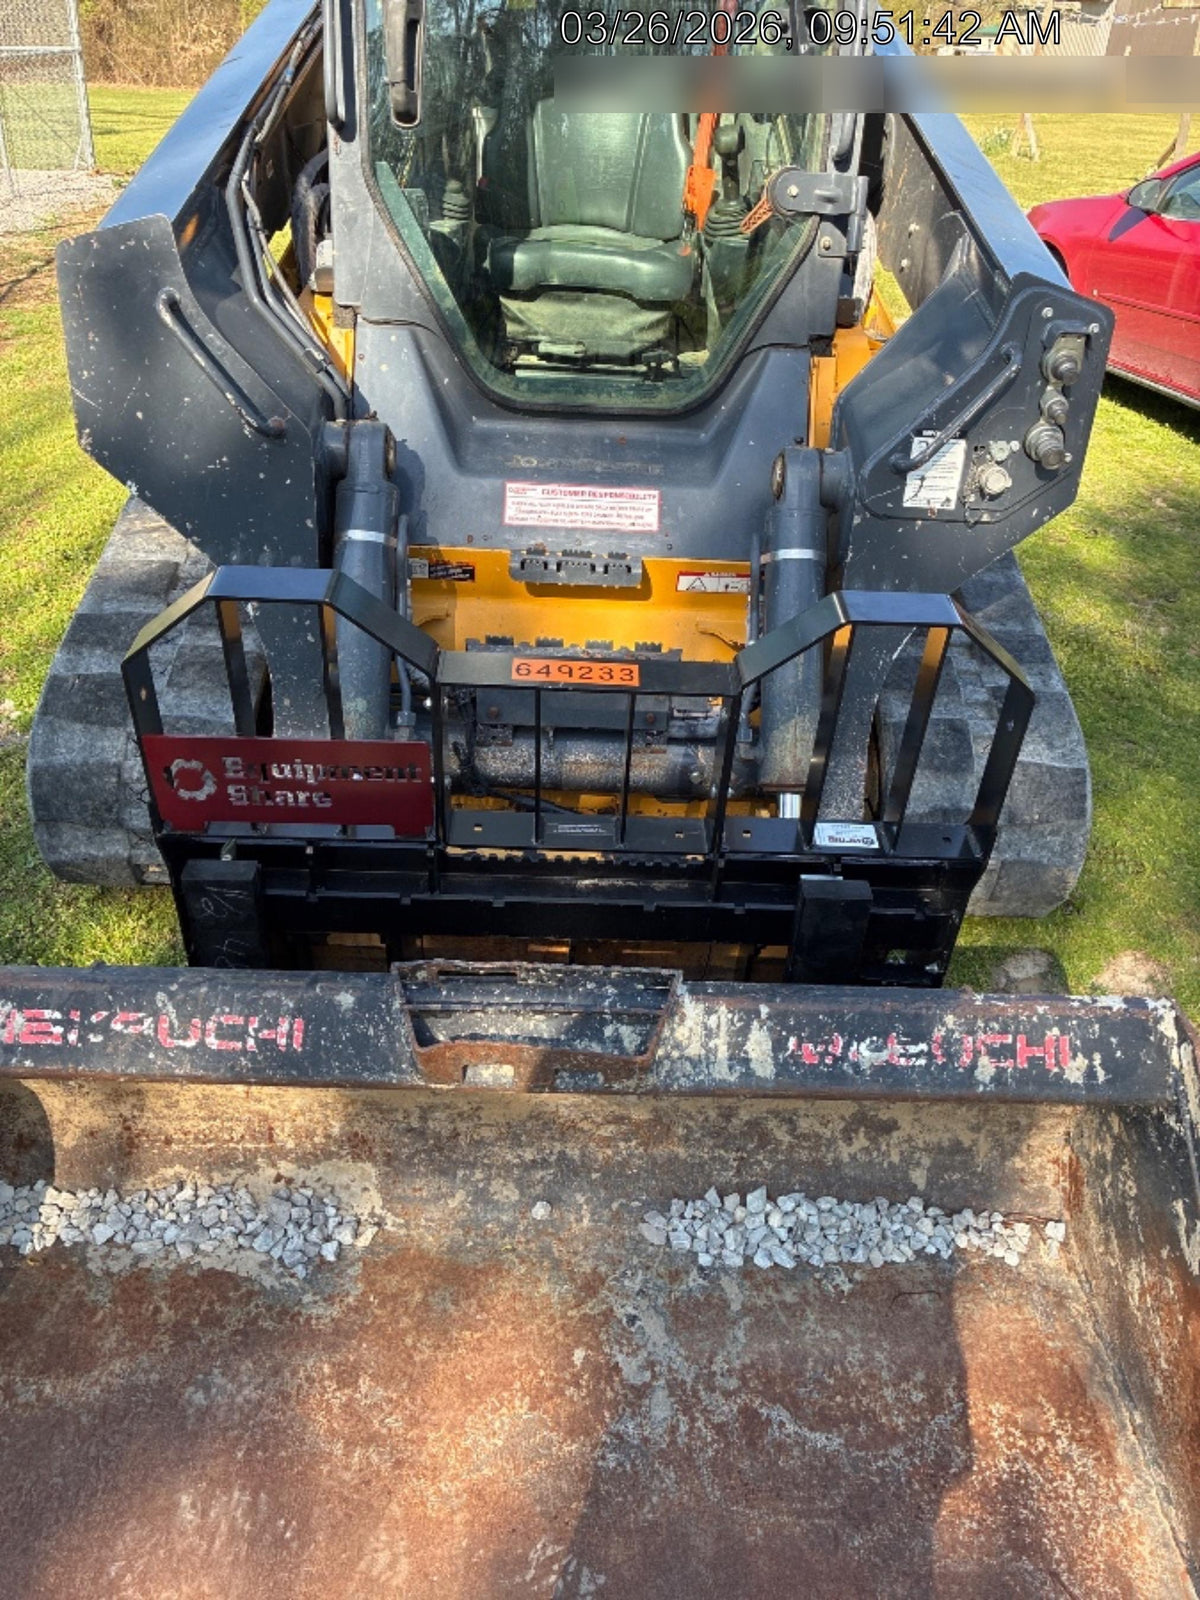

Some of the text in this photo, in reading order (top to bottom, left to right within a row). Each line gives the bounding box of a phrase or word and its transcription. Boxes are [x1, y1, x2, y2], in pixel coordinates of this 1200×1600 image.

[515, 662, 635, 683] 649233
[221, 757, 423, 785] Equipment
[226, 784, 333, 808] Share
